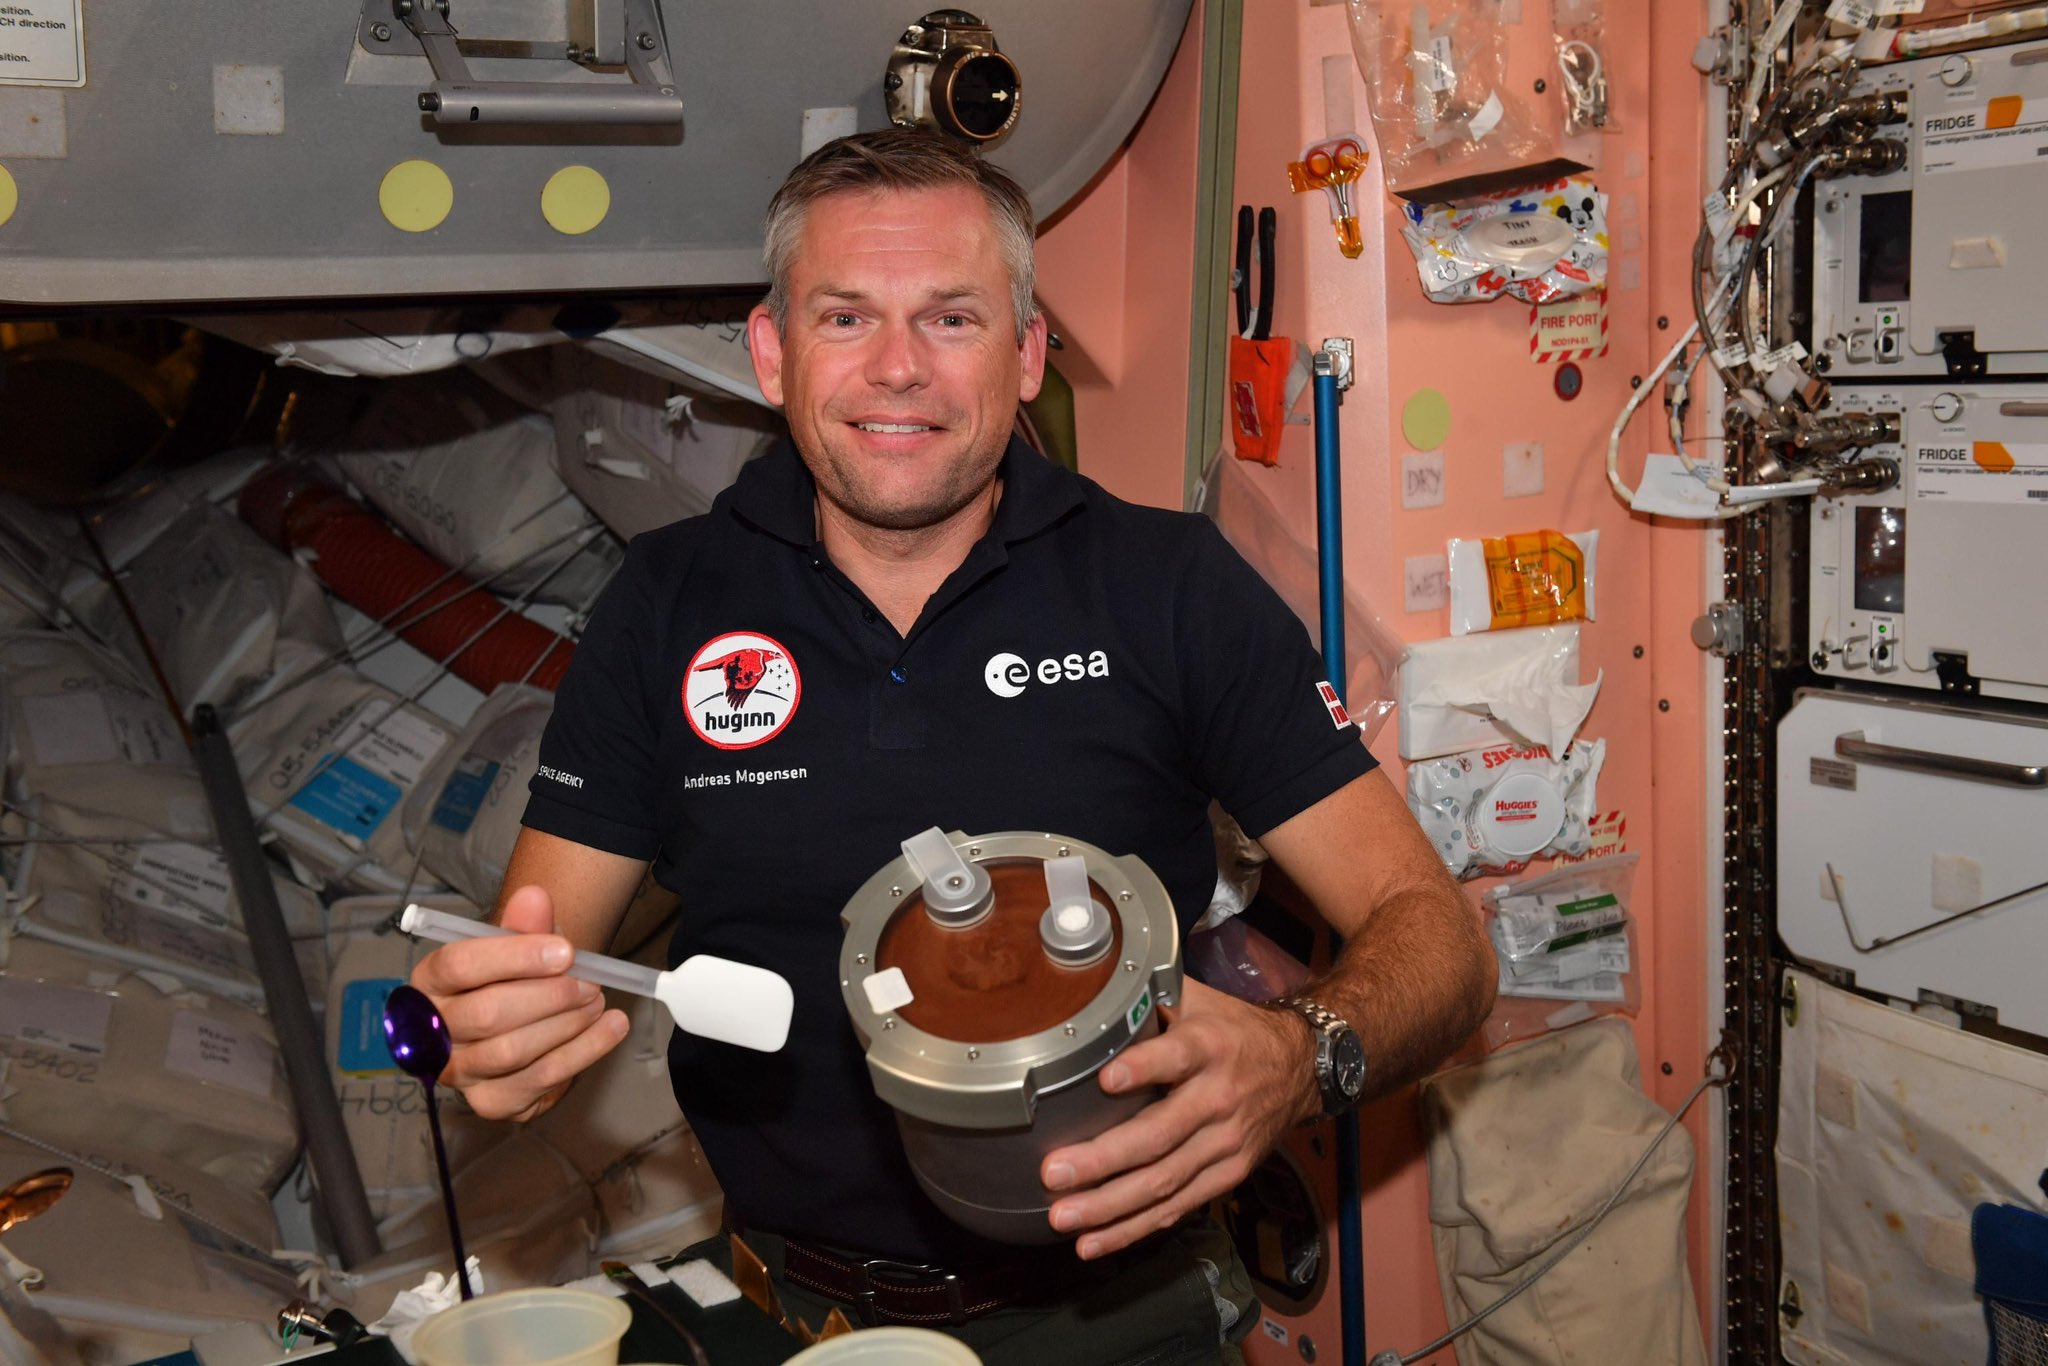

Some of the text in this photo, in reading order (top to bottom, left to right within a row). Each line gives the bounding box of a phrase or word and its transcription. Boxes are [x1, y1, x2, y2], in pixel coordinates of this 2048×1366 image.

[0, 7, 33, 16] sition.
[0, 17, 66, 29] CH direction
[1925, 114, 1976, 133] FRIDGE
[1502, 220, 1532, 230] TINY
[1506, 237, 1539, 248] TRASH
[1541, 313, 1598, 329] FIRE PORT
[1918, 449, 1967, 461] FRIDGE
[1407, 468, 1442, 496] DRY
[1409, 571, 1445, 598] WET
[1037, 650, 1109, 685] esa
[704, 711, 776, 733] huginn
[538, 765, 585, 789] SPACE AGENCY
[684, 765, 808, 791] Andreas Mogensen
[1496, 799, 1538, 811] HUGGIES
[1588, 843, 1617, 859] PORT
